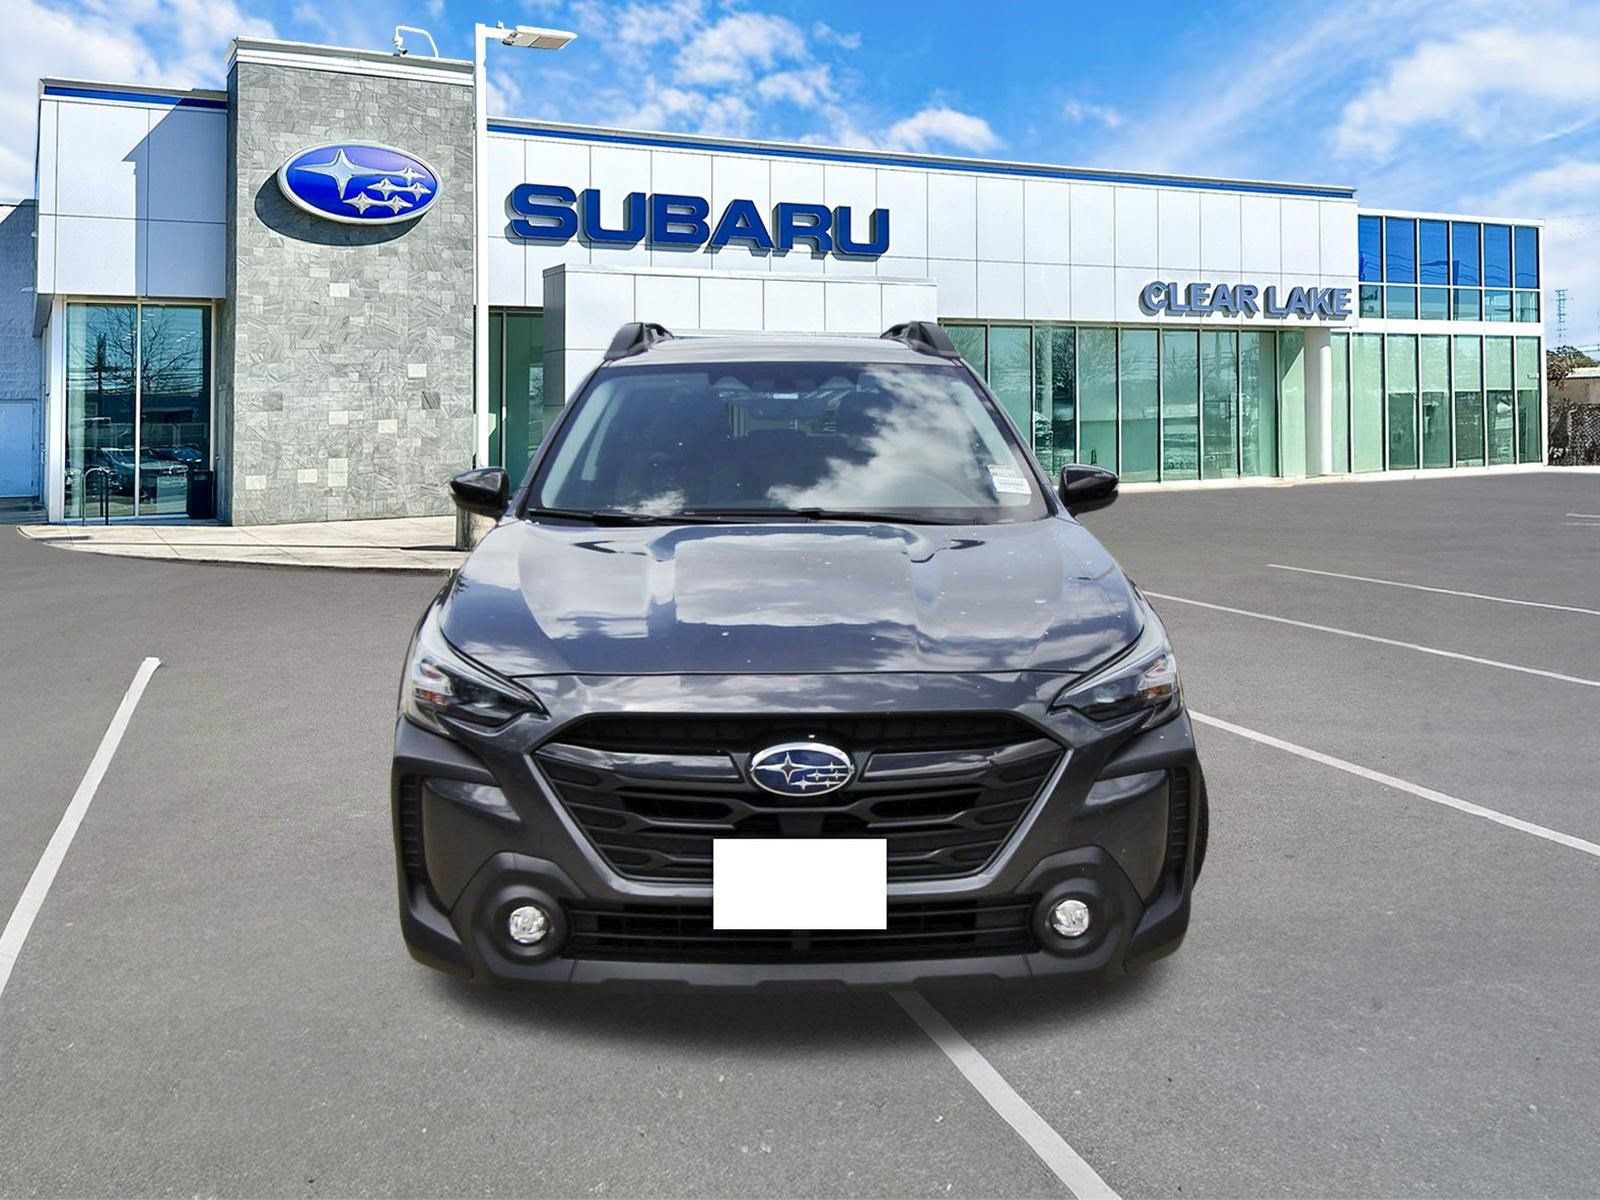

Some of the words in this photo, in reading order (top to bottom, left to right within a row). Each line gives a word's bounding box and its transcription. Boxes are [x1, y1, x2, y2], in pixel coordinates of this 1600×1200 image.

[506, 183, 890, 257] SUBARU
[1140, 281, 1260, 317] CLEAR
[1264, 286, 1353, 319] LAKE
